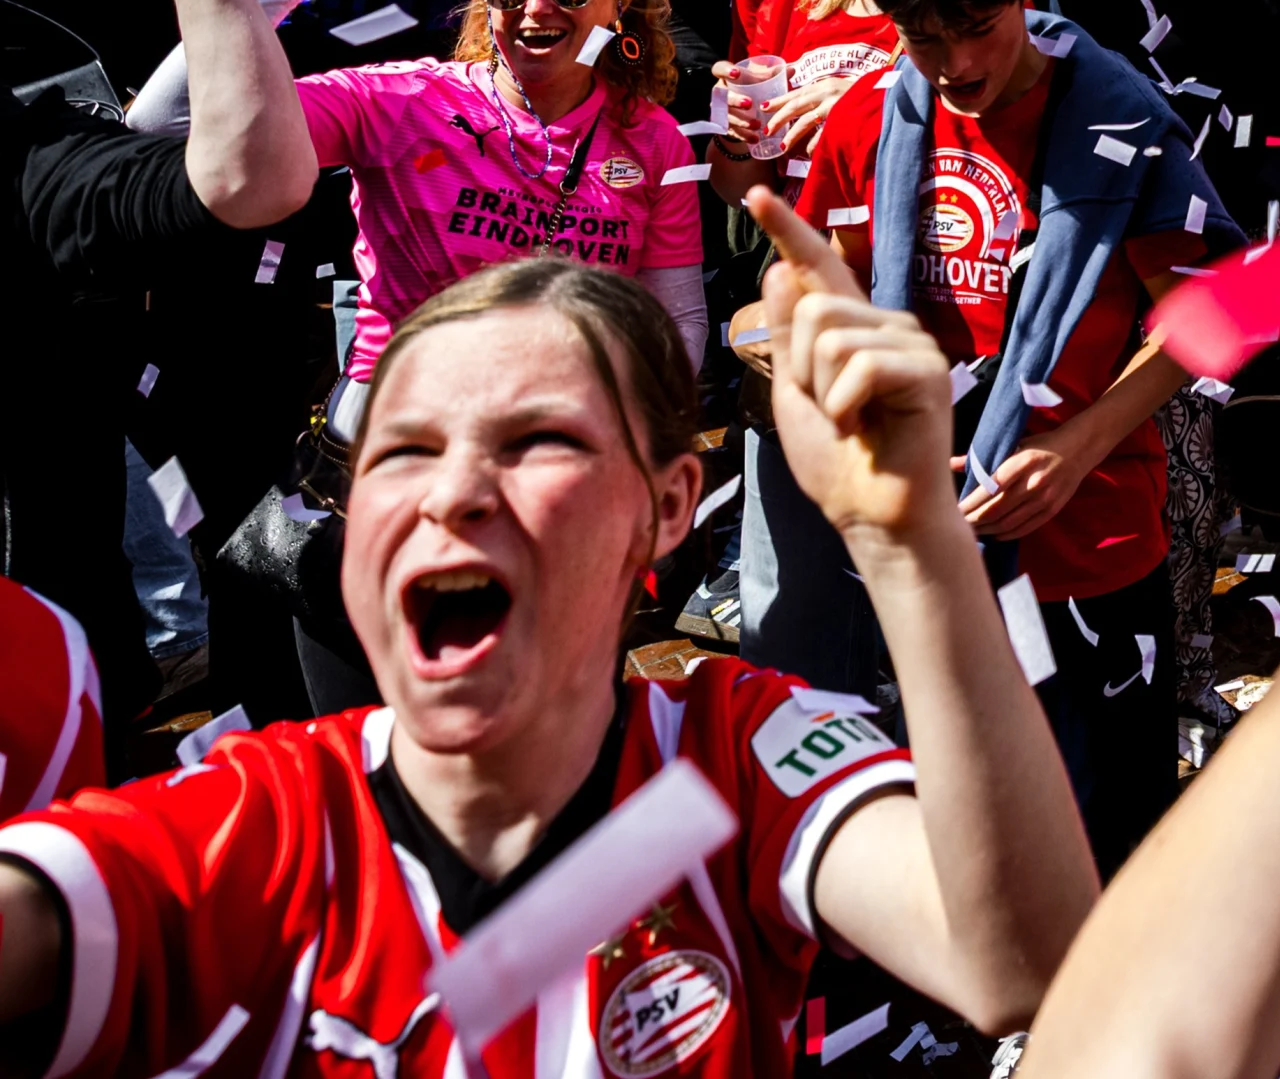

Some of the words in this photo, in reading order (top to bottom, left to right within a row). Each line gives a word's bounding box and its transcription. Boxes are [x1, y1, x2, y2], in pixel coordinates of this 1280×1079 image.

[614, 166, 628, 175] PSV
[939, 159, 963, 172] VAN
[456, 187, 629, 240] BRAINPORT
[933, 221, 954, 232] PSV
[636, 987, 680, 1032] PSV
